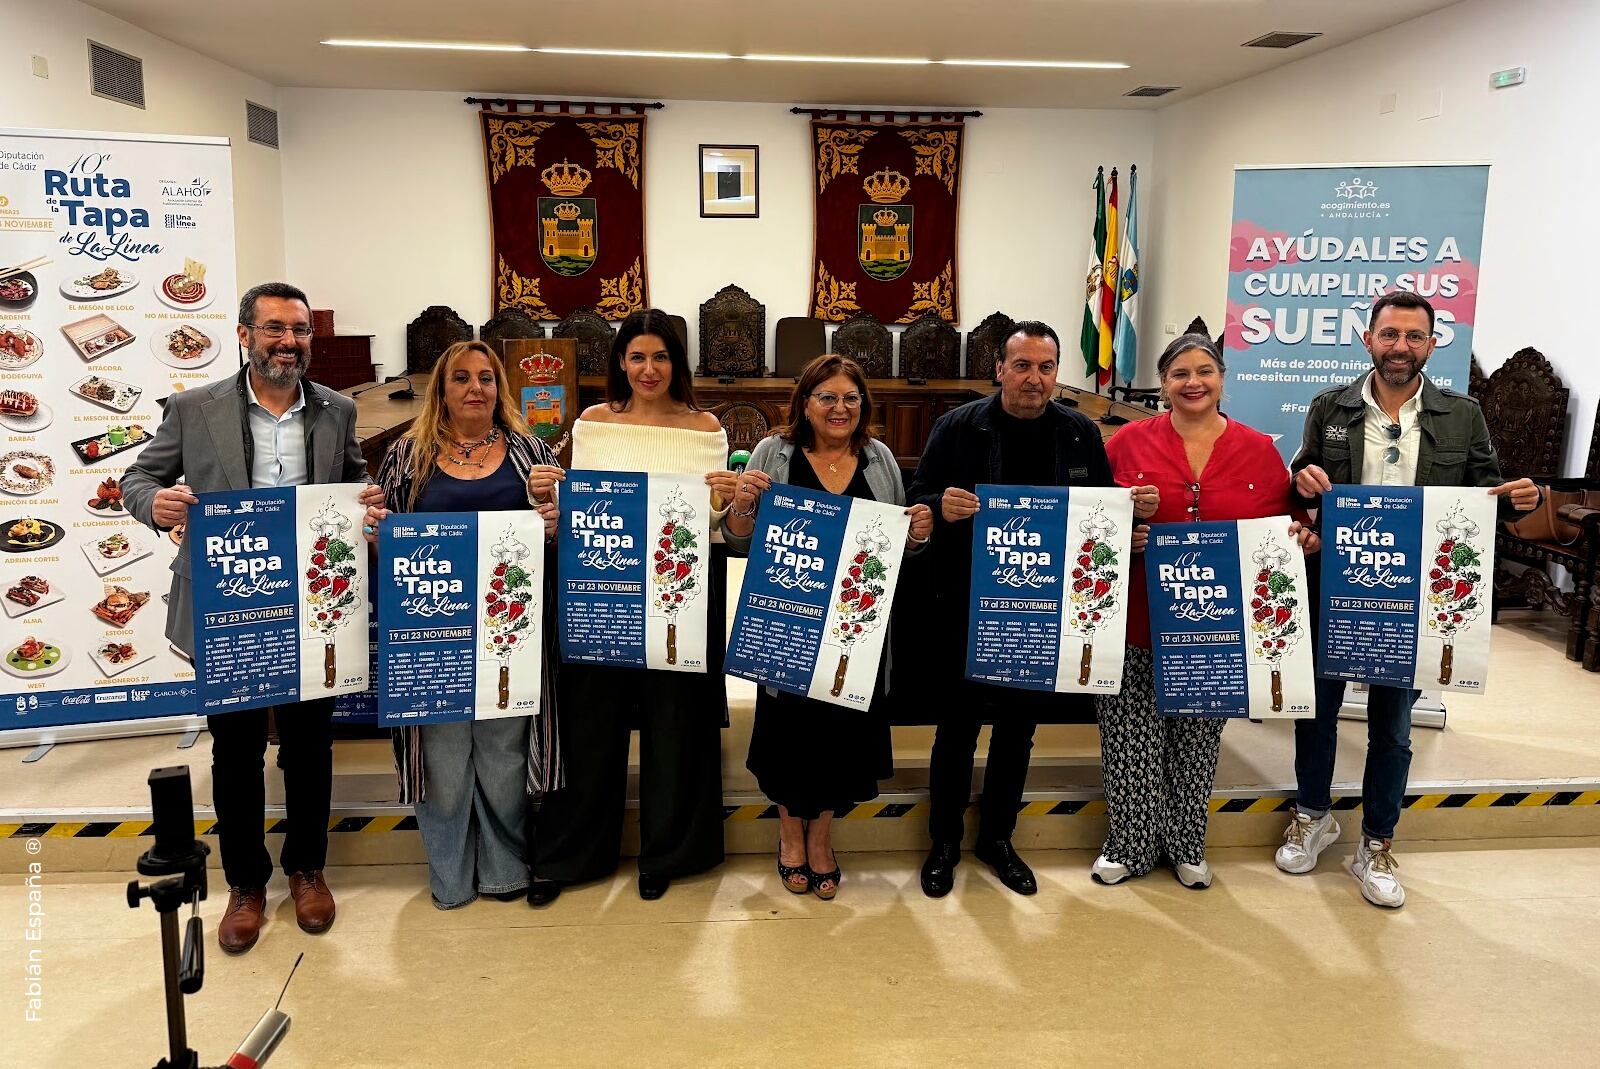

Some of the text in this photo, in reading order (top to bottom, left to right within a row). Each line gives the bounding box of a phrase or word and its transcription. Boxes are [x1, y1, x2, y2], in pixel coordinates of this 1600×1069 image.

[13, 162, 36, 170] Cádiz
[45, 169, 130, 198] Ruta
[1320, 202, 1390, 210] acogimiento.es
[5, 220, 53, 228] NOVIEMBRE
[60, 200, 150, 235] Tapa
[59, 232, 73, 243] de
[1246, 228, 1461, 263] AYÚDALES A
[1244, 272, 1459, 298] CUMPLIR SUS
[1241, 302, 1455, 348] SUEÑS
[1260, 359, 1375, 370] Más de 2000 niña
[1237, 373, 1328, 383] necesitan una
[572, 511, 623, 529] Ruta
[580, 530, 634, 553] Tapa
[766, 524, 819, 550] Ruta
[986, 526, 1041, 546] Ruta
[1336, 527, 1395, 546] Ruta
[206, 535, 269, 556] Ruta
[578, 550, 586, 558] de
[394, 557, 452, 575] Ruta
[772, 545, 825, 573] Tapa
[994, 546, 1051, 571] Tapa
[1345, 546, 1406, 570] Tapa
[217, 556, 282, 579] Tapa
[766, 566, 775, 574] de
[992, 568, 1001, 576] de
[1159, 564, 1215, 581] Ruta
[1343, 567, 1353, 576] de
[216, 579, 227, 589] de
[403, 577, 463, 599] Tapa
[598, 583, 641, 592] NOVIEMBRE
[1169, 582, 1228, 604] Tapa
[401, 598, 411, 607] de
[749, 596, 823, 616] 19 al 23 NOVIEMBRE
[1012, 602, 1057, 610] NOVIEMBRE
[1352, 600, 1362, 608] 23
[1364, 601, 1414, 611] NOVIEMBRE
[206, 608, 294, 625] 19 al 23 NOVIEMBRE
[389, 633, 399, 641] 19
[411, 631, 421, 640] 23
[424, 629, 472, 639] NOVIEMBRE
[1194, 634, 1240, 642] NOVIEMBRE
